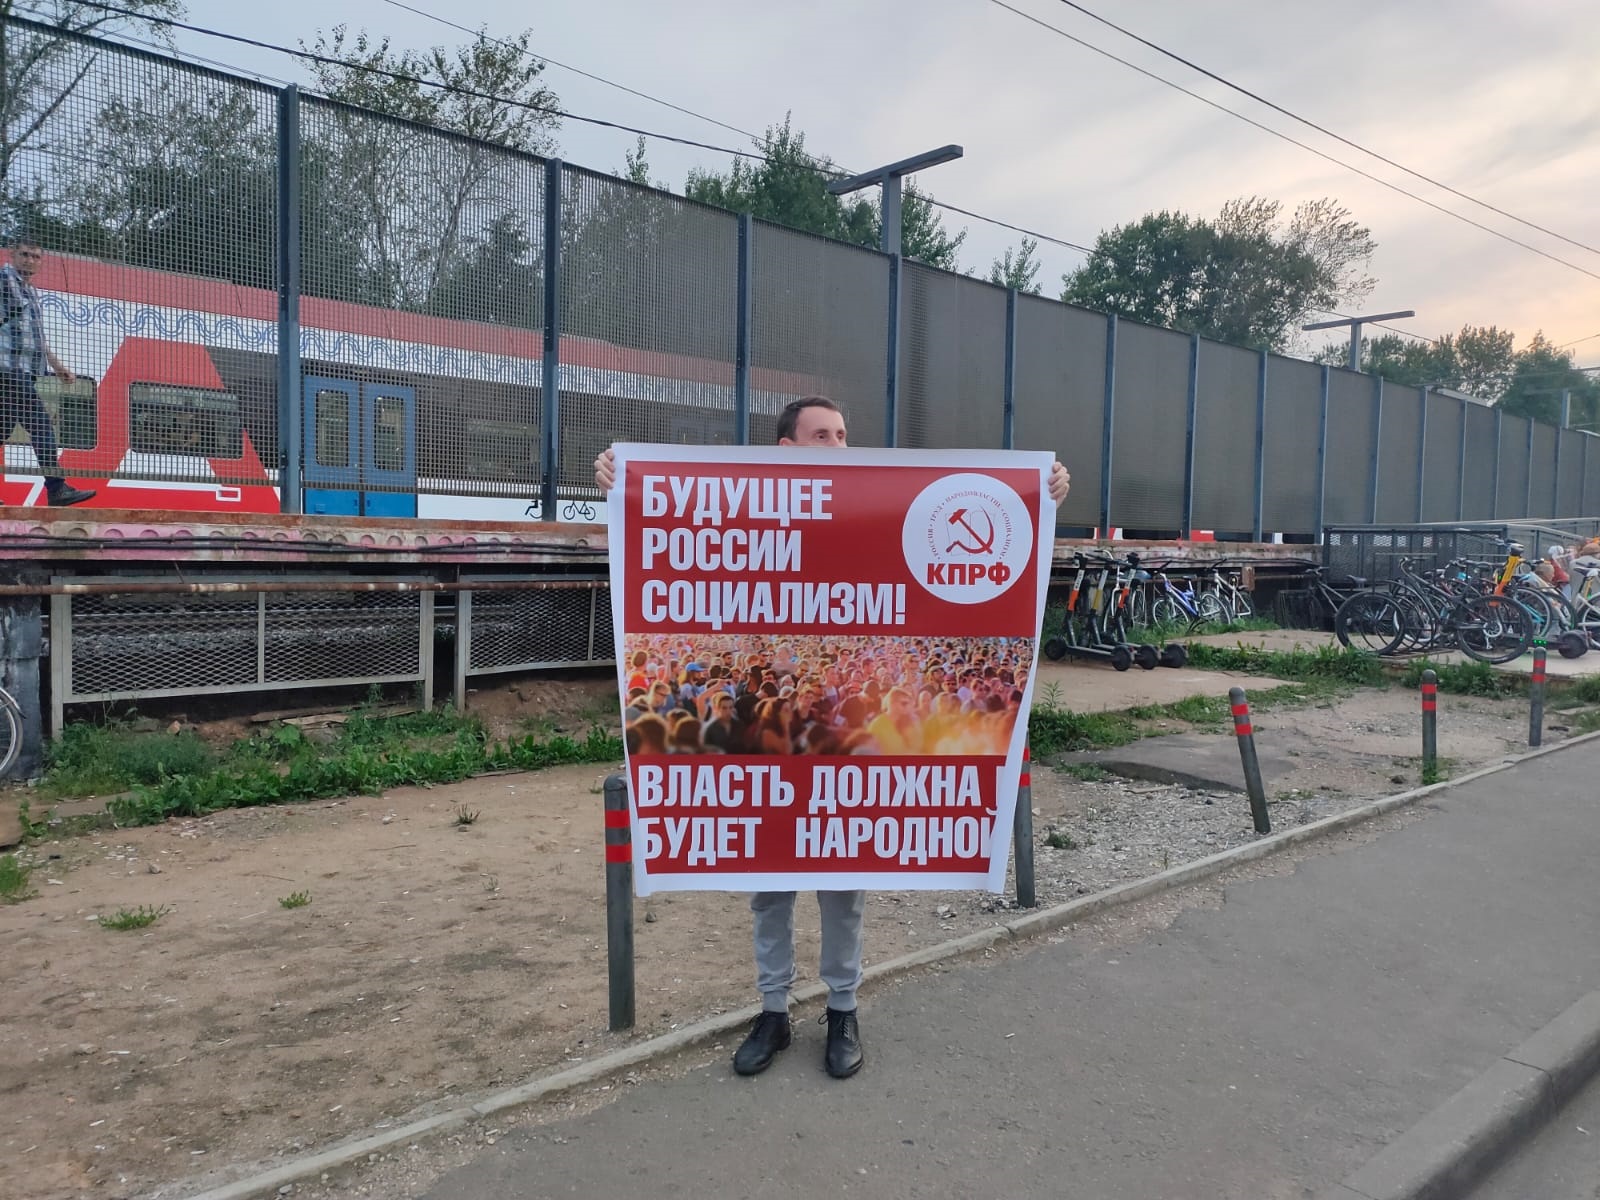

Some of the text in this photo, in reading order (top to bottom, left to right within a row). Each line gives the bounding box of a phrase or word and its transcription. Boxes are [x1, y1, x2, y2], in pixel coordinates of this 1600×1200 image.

[642, 475, 833, 526] БУДУЩЕЕ
[642, 527, 802, 572] РОССИИ
[927, 562, 1011, 585] КПРФ
[641, 579, 906, 630] СОЦИАЛИЗМ!
[638, 765, 794, 807] ВЛАСТЬ
[809, 765, 982, 814] ДОЛЖНА
[638, 816, 762, 866] БУДЕТ
